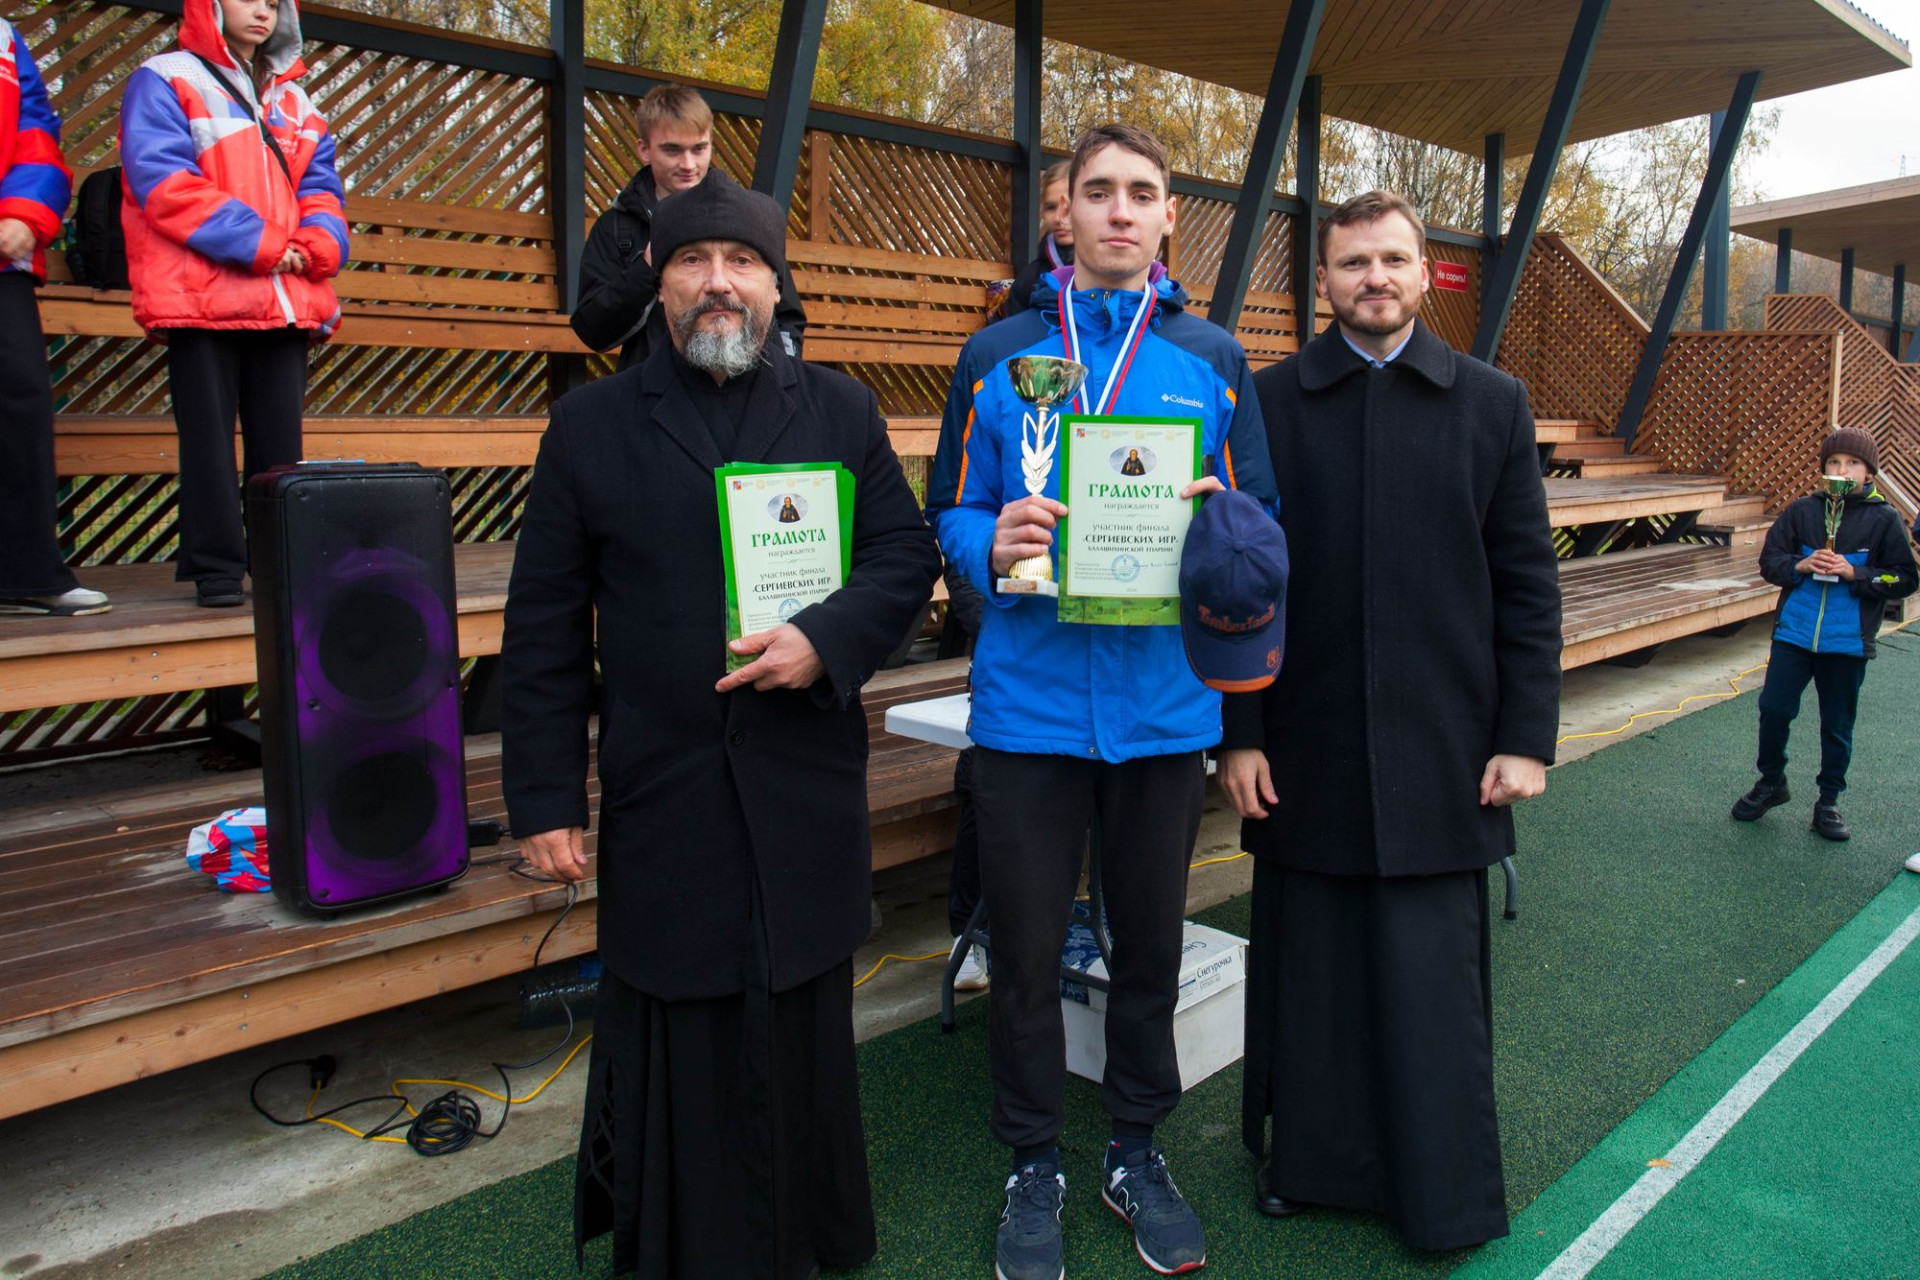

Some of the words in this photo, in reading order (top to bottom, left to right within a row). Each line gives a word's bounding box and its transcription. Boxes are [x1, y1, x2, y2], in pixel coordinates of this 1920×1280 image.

[1437, 269, 1445, 280] Не
[1170, 394, 1204, 408] Columbia
[1088, 484, 1175, 499] ГРАМОТА
[1104, 503, 1160, 512] награждается
[1092, 523, 1133, 532] участник
[1136, 523, 1170, 533] финала
[751, 528, 826, 547] ГРАМОТА
[768, 548, 815, 557] награждается
[759, 569, 798, 581] участник
[799, 567, 826, 578] финала
[1196, 955, 1232, 978] Снегурочка
